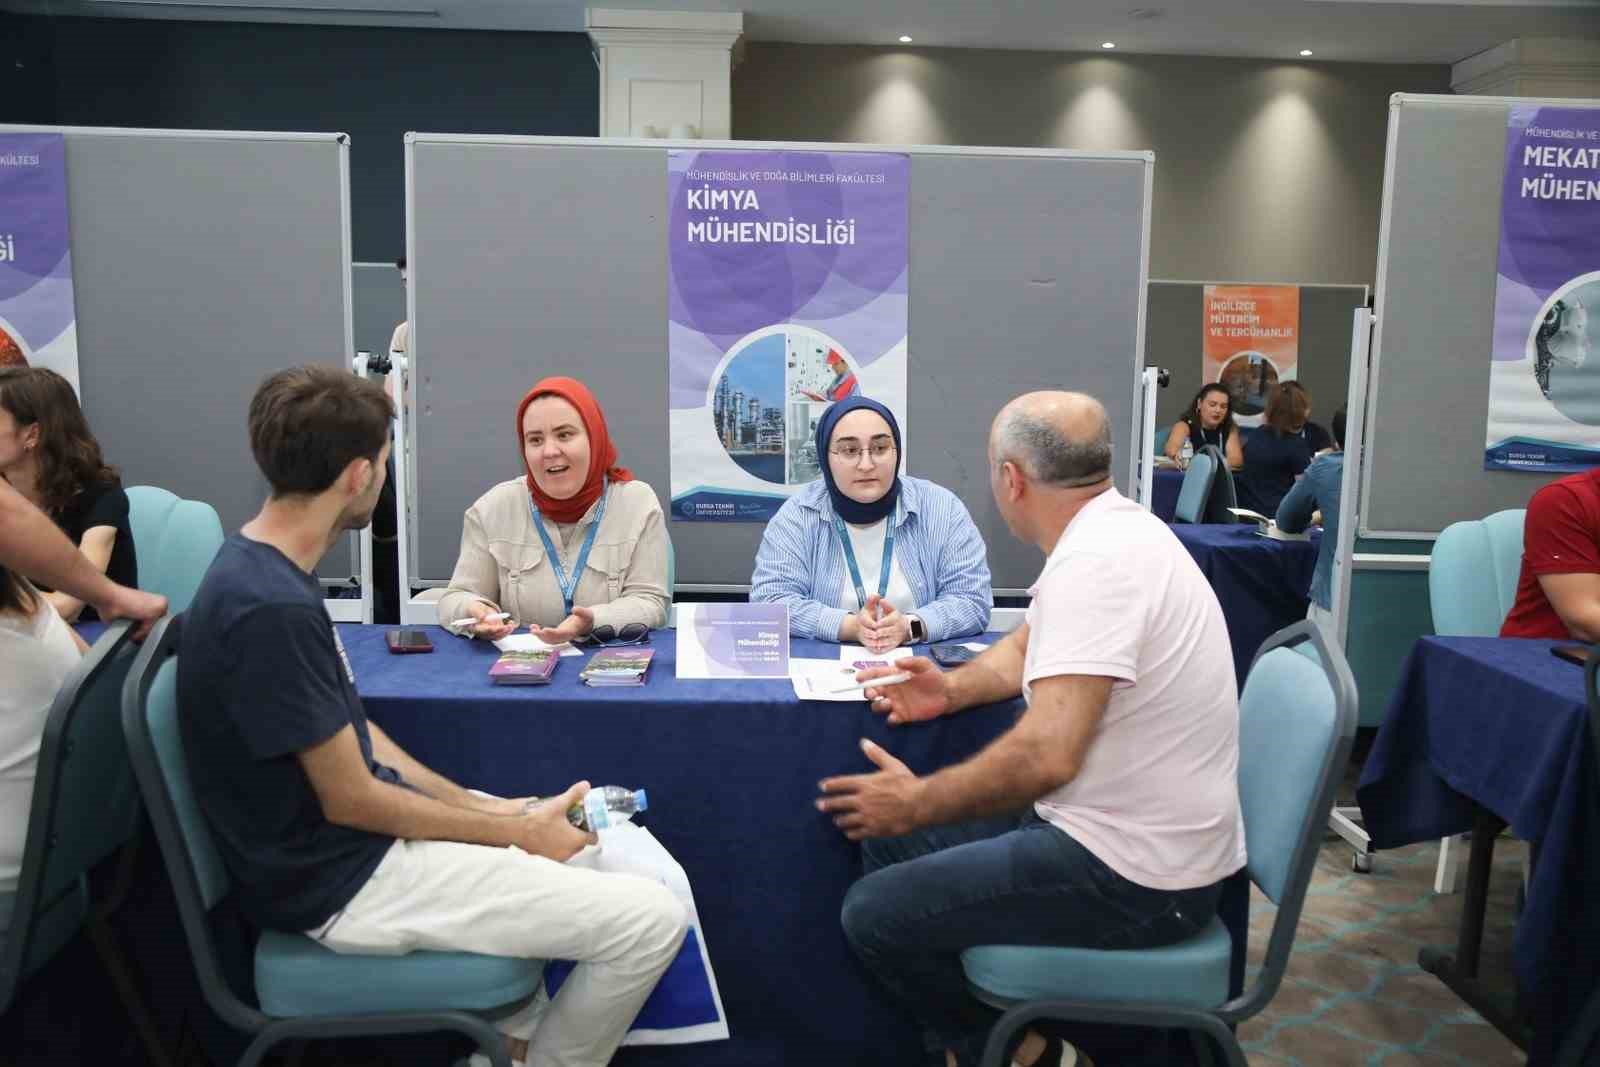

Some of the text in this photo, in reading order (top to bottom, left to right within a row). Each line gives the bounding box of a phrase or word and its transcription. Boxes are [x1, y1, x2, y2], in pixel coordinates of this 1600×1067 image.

[1524, 145, 1600, 168] MEKAT
[687, 168, 748, 181] MÜHENDİSLİK
[751, 171, 761, 181] VE
[764, 169, 788, 182] DOĞA
[790, 170, 835, 183] BİLİMLERİ
[687, 184, 759, 210] KİMYA
[687, 217, 855, 245] MÜHENDİSLİĞİ
[1210, 327, 1224, 336] VE
